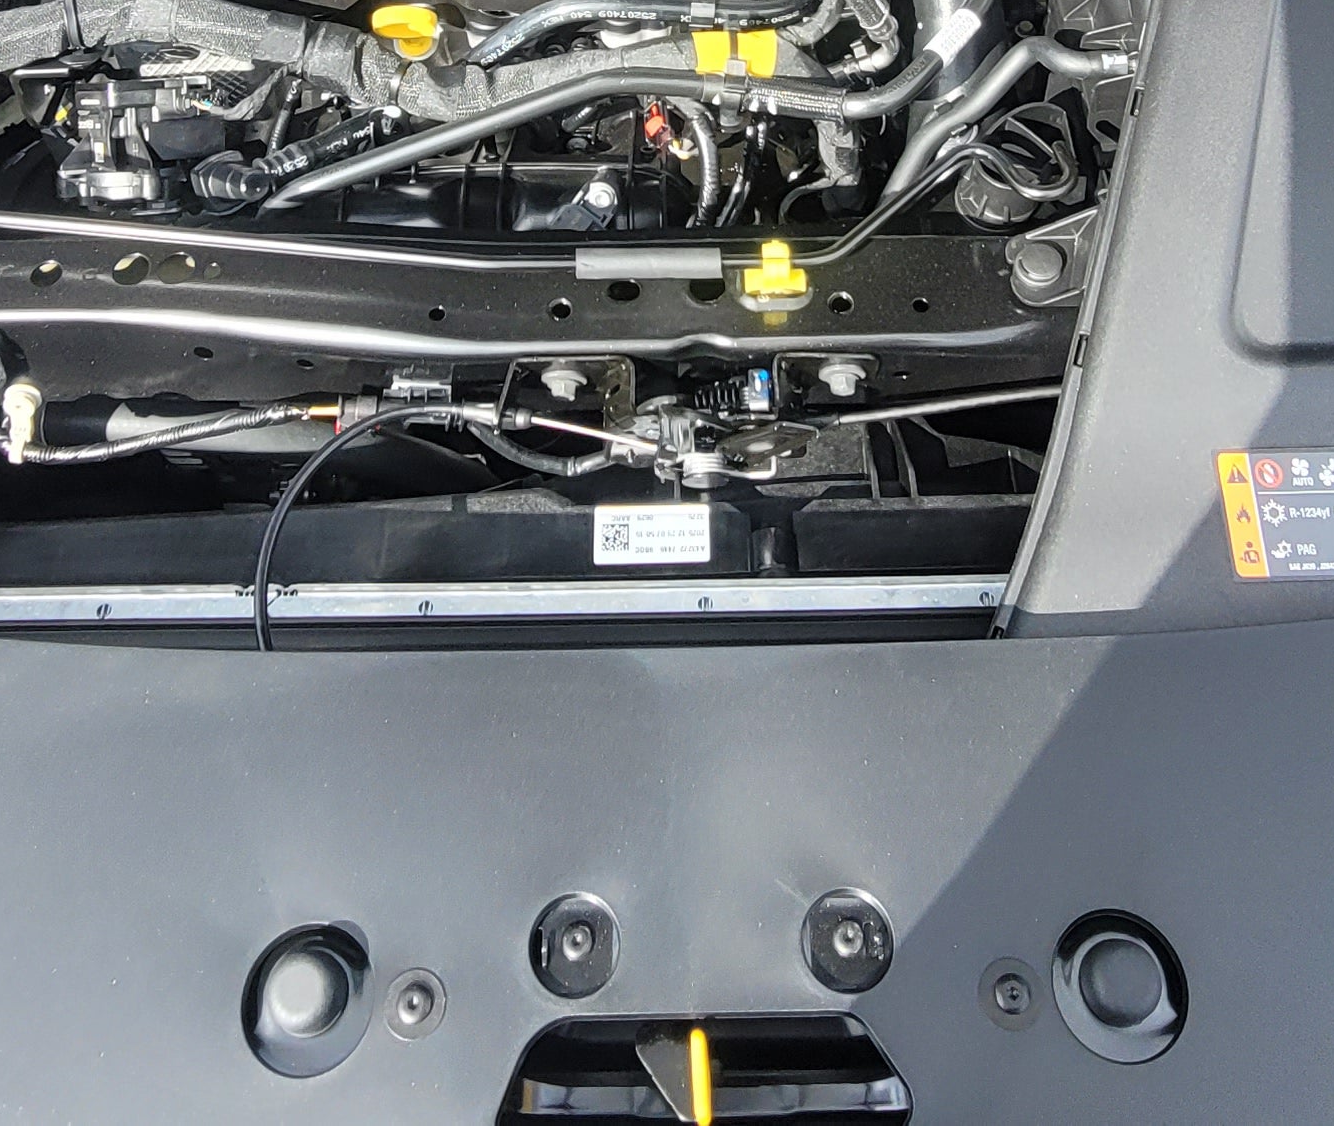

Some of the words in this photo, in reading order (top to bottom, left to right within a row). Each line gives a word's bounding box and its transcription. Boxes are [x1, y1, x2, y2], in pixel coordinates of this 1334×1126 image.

[570, 10, 593, 20] 540
[598, 10, 657, 20] 25207409
[1292, 477, 1314, 487] AUTO
[1288, 507, 1331, 520] R-1234yf
[1296, 543, 1317, 556] PAG
